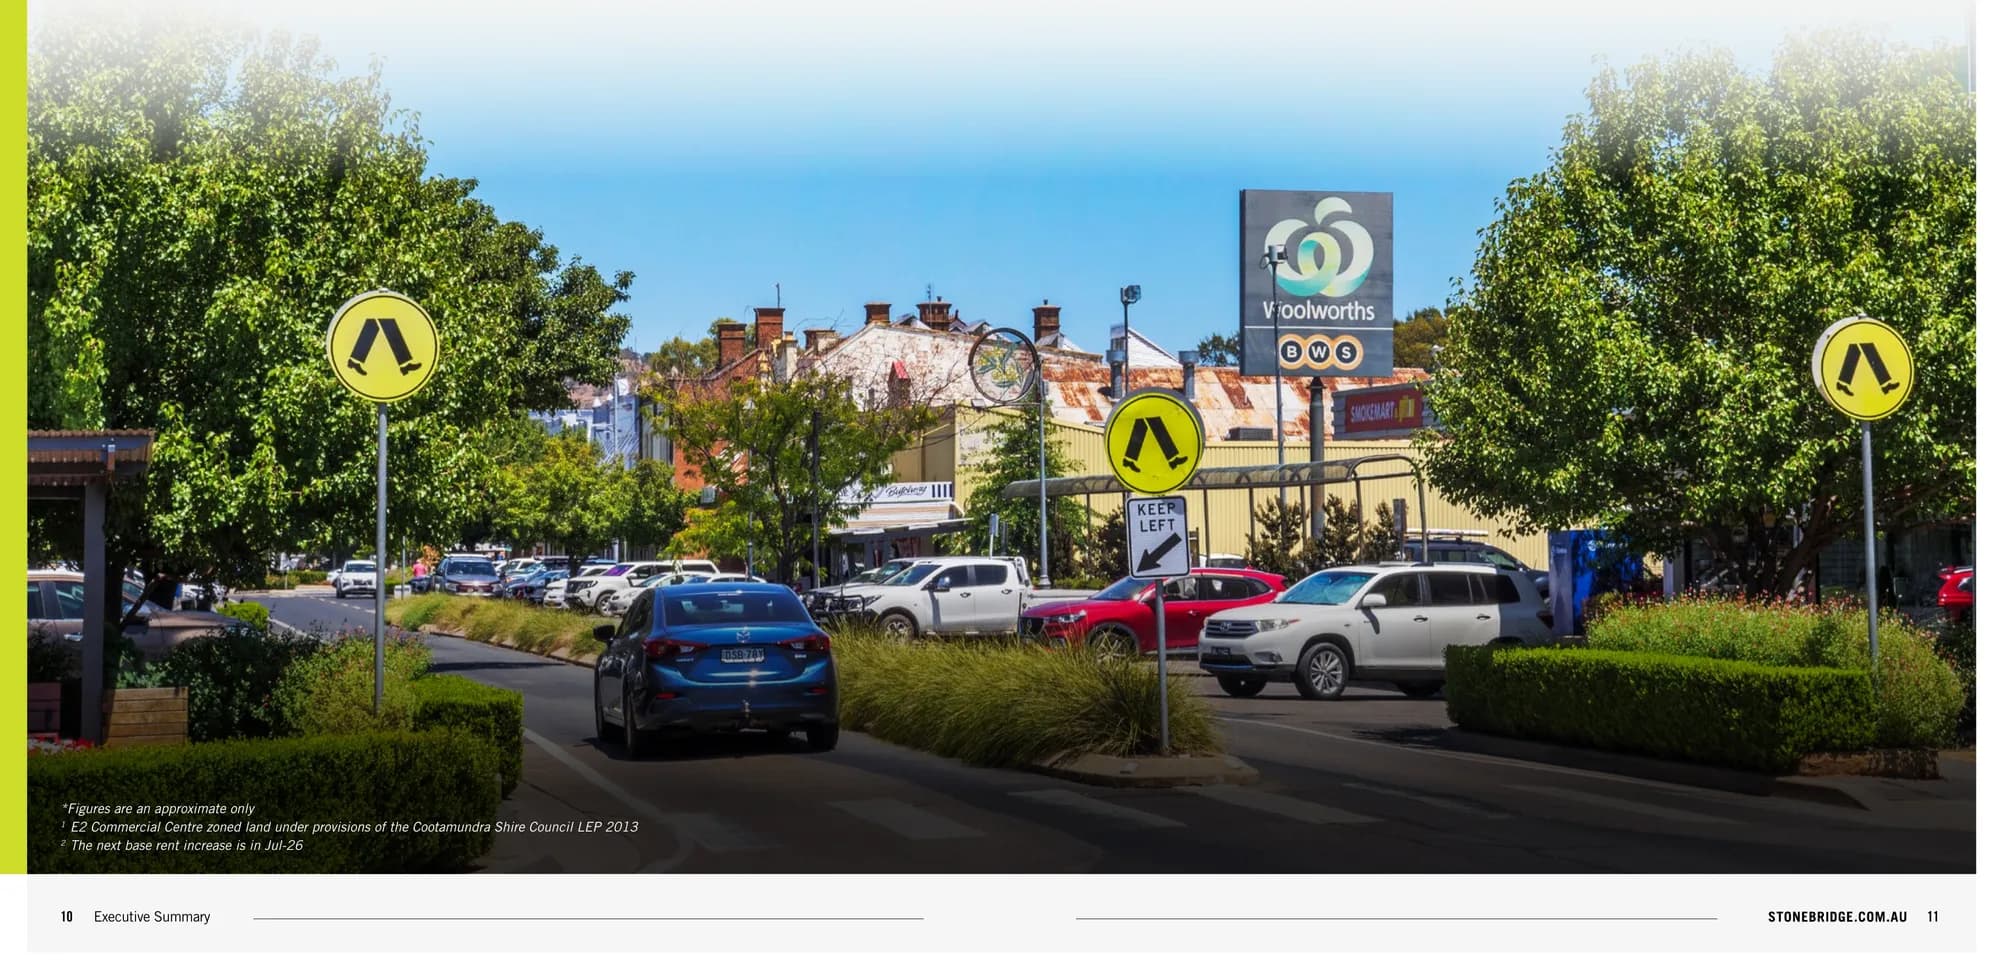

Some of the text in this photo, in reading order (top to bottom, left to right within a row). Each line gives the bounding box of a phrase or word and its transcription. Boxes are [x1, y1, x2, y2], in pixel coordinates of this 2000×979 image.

[1263, 300, 1375, 320] Woolworths
[1286, 345, 1352, 359] BWS
[1350, 401, 1395, 422] SMOKEMART
[1137, 502, 1176, 516] KEEP
[1140, 518, 1175, 532] LEFT
